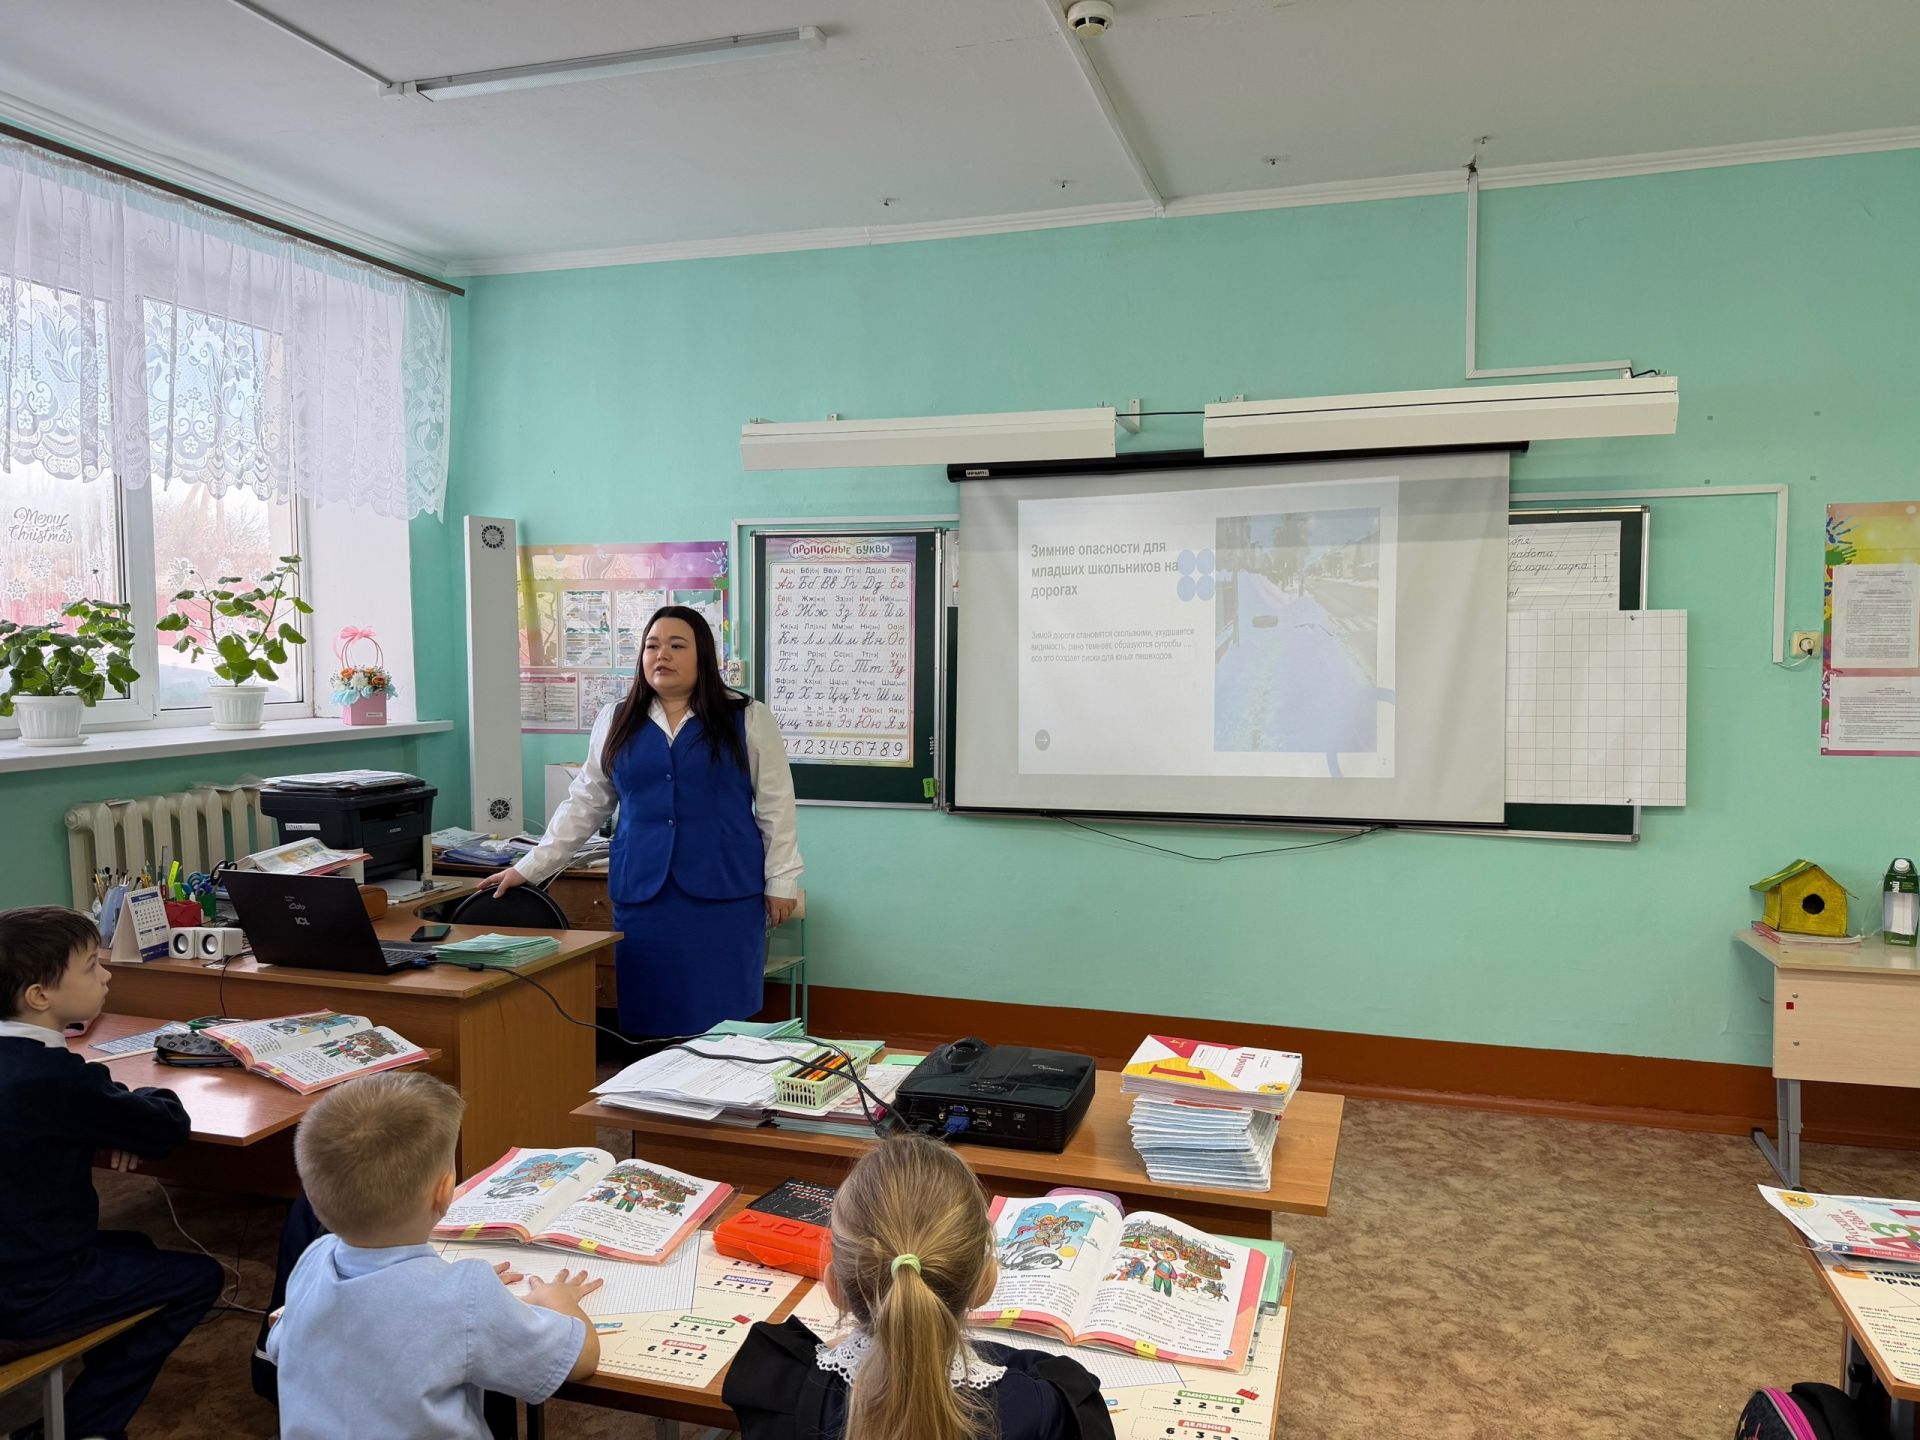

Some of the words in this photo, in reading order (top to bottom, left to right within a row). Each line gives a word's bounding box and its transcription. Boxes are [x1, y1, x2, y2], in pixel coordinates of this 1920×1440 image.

[13, 506, 70, 528] Merry
[8, 524, 73, 544] Christmas
[856, 545, 889, 554] БУКВЫ
[1031, 543, 1075, 557] Зимние
[1078, 543, 1140, 556] опасности
[1143, 542, 1166, 555] для
[1032, 564, 1084, 578] младших
[1088, 561, 1161, 575] школьников
[1164, 561, 1178, 572] на
[1031, 584, 1077, 600] дорогах
[1231, 1052, 1256, 1078] Прописи
[1181, 1391, 1242, 1404] УМНОЖЕНИЕ
[1182, 1421, 1227, 1432] ДЕЛЕНИЕ
